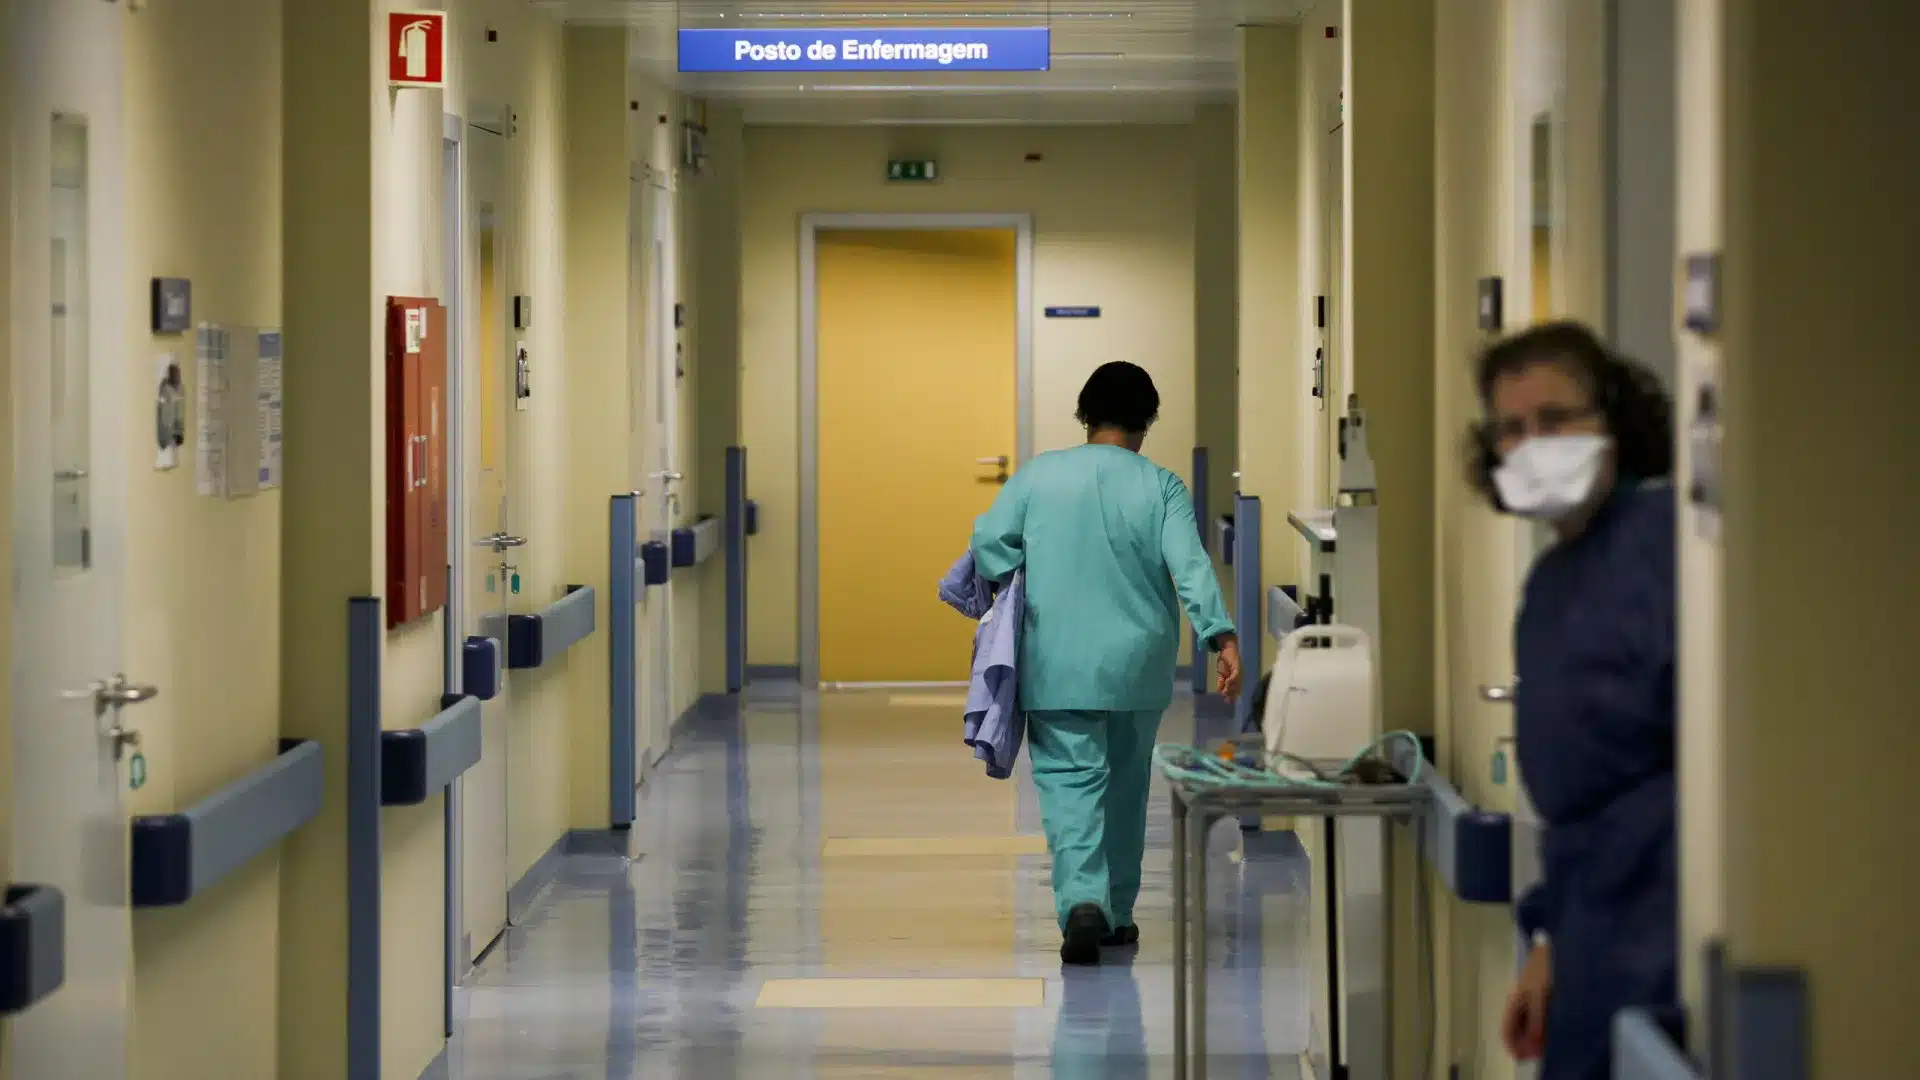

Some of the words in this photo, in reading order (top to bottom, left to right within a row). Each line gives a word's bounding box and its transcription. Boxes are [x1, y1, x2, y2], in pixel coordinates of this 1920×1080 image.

[734, 40, 801, 61] Posto
[807, 40, 836, 61] de
[842, 39, 988, 64] Enfermagem
